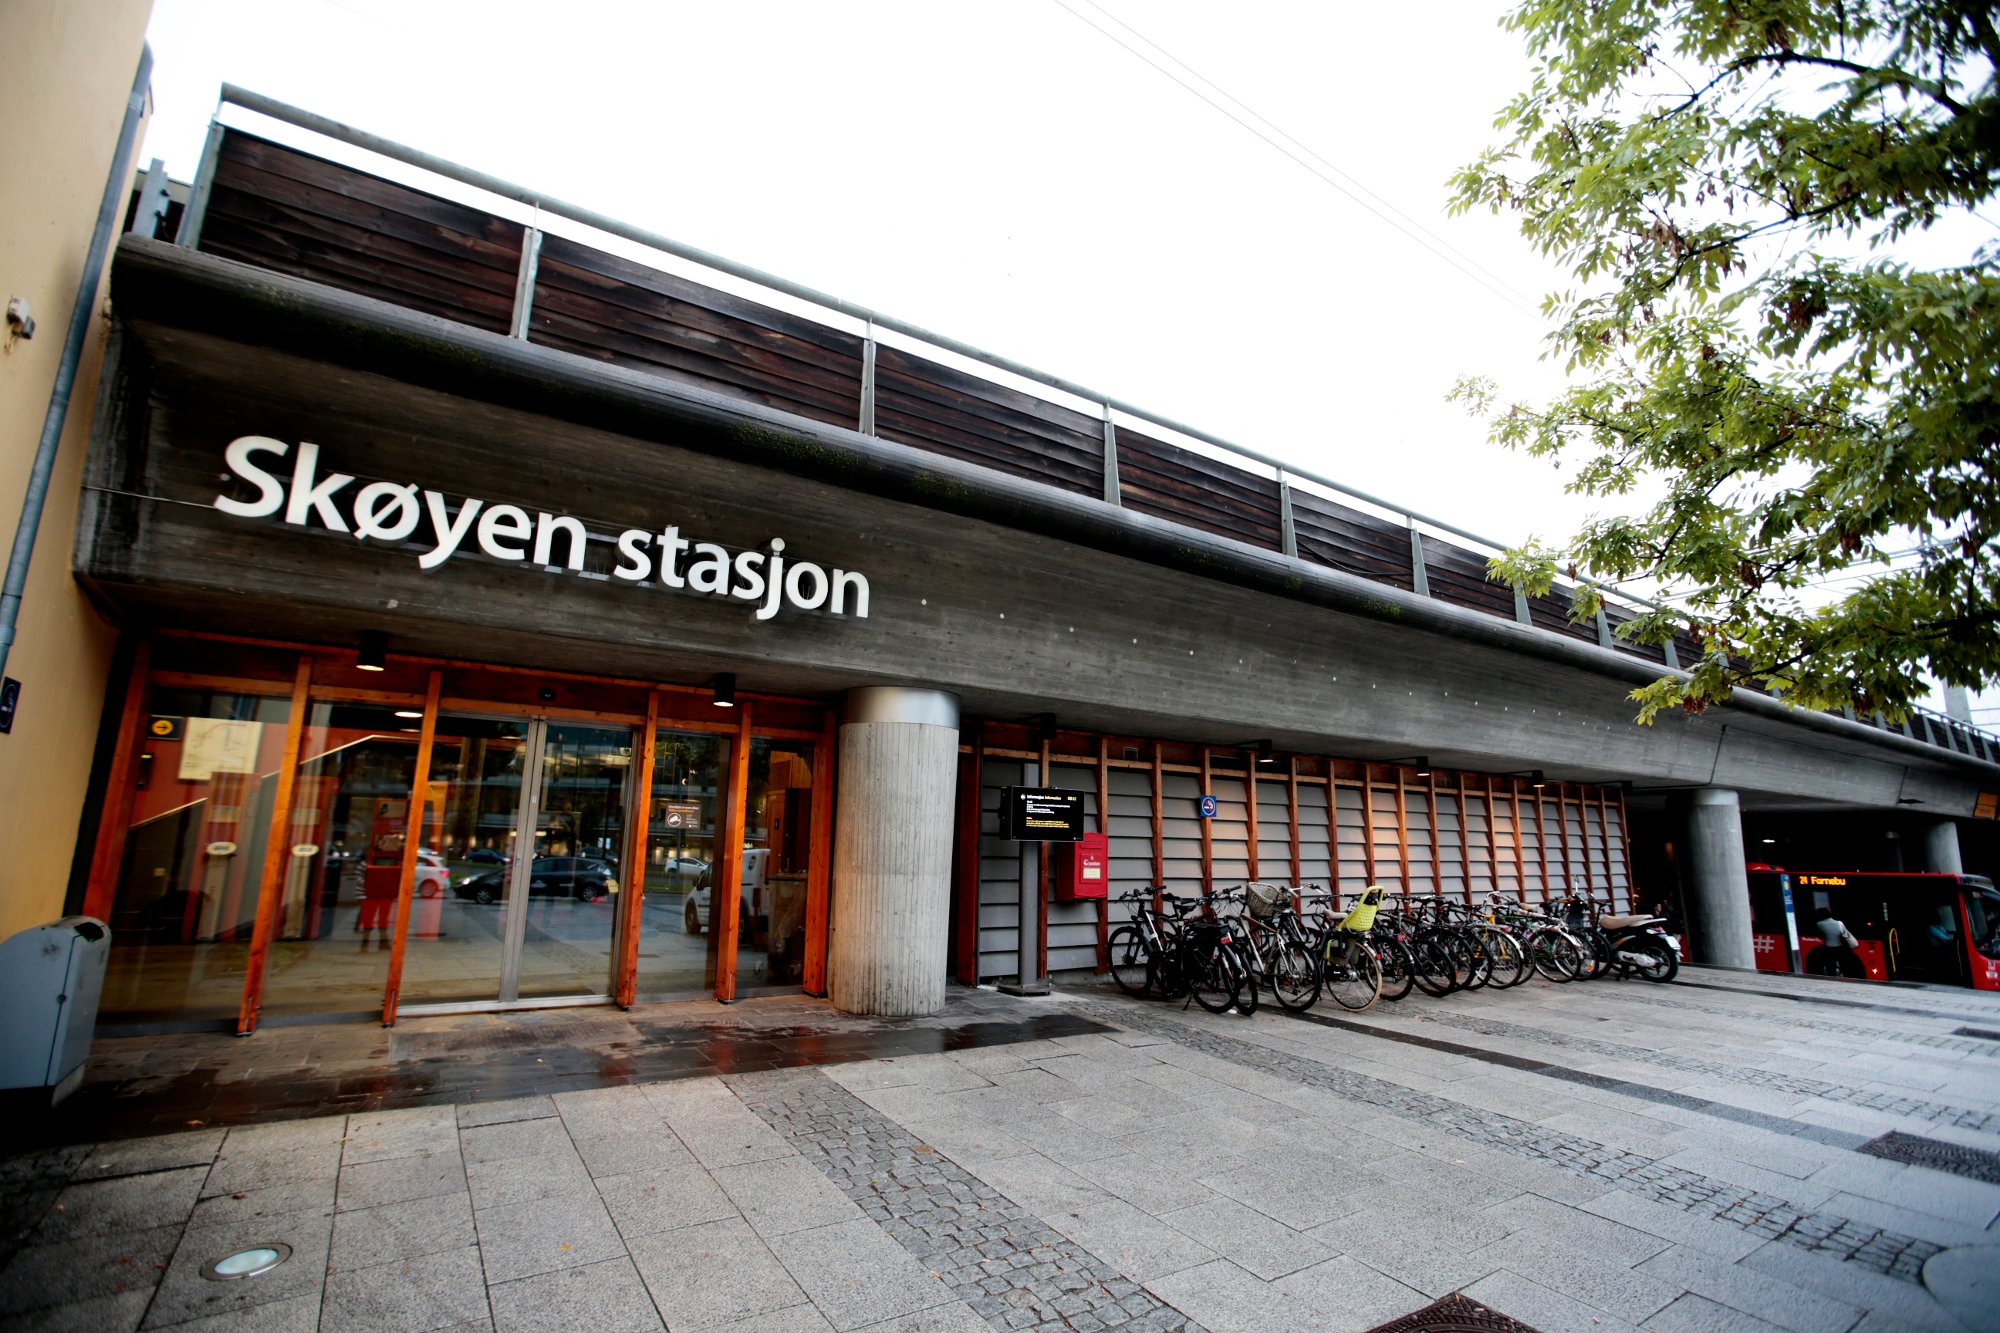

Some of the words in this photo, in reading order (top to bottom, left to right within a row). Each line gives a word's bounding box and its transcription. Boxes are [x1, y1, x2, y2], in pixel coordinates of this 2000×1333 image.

[214, 435, 588, 571] Skøyen
[613, 525, 870, 620] stasjon
[1810, 876, 1846, 886] Fornebu
